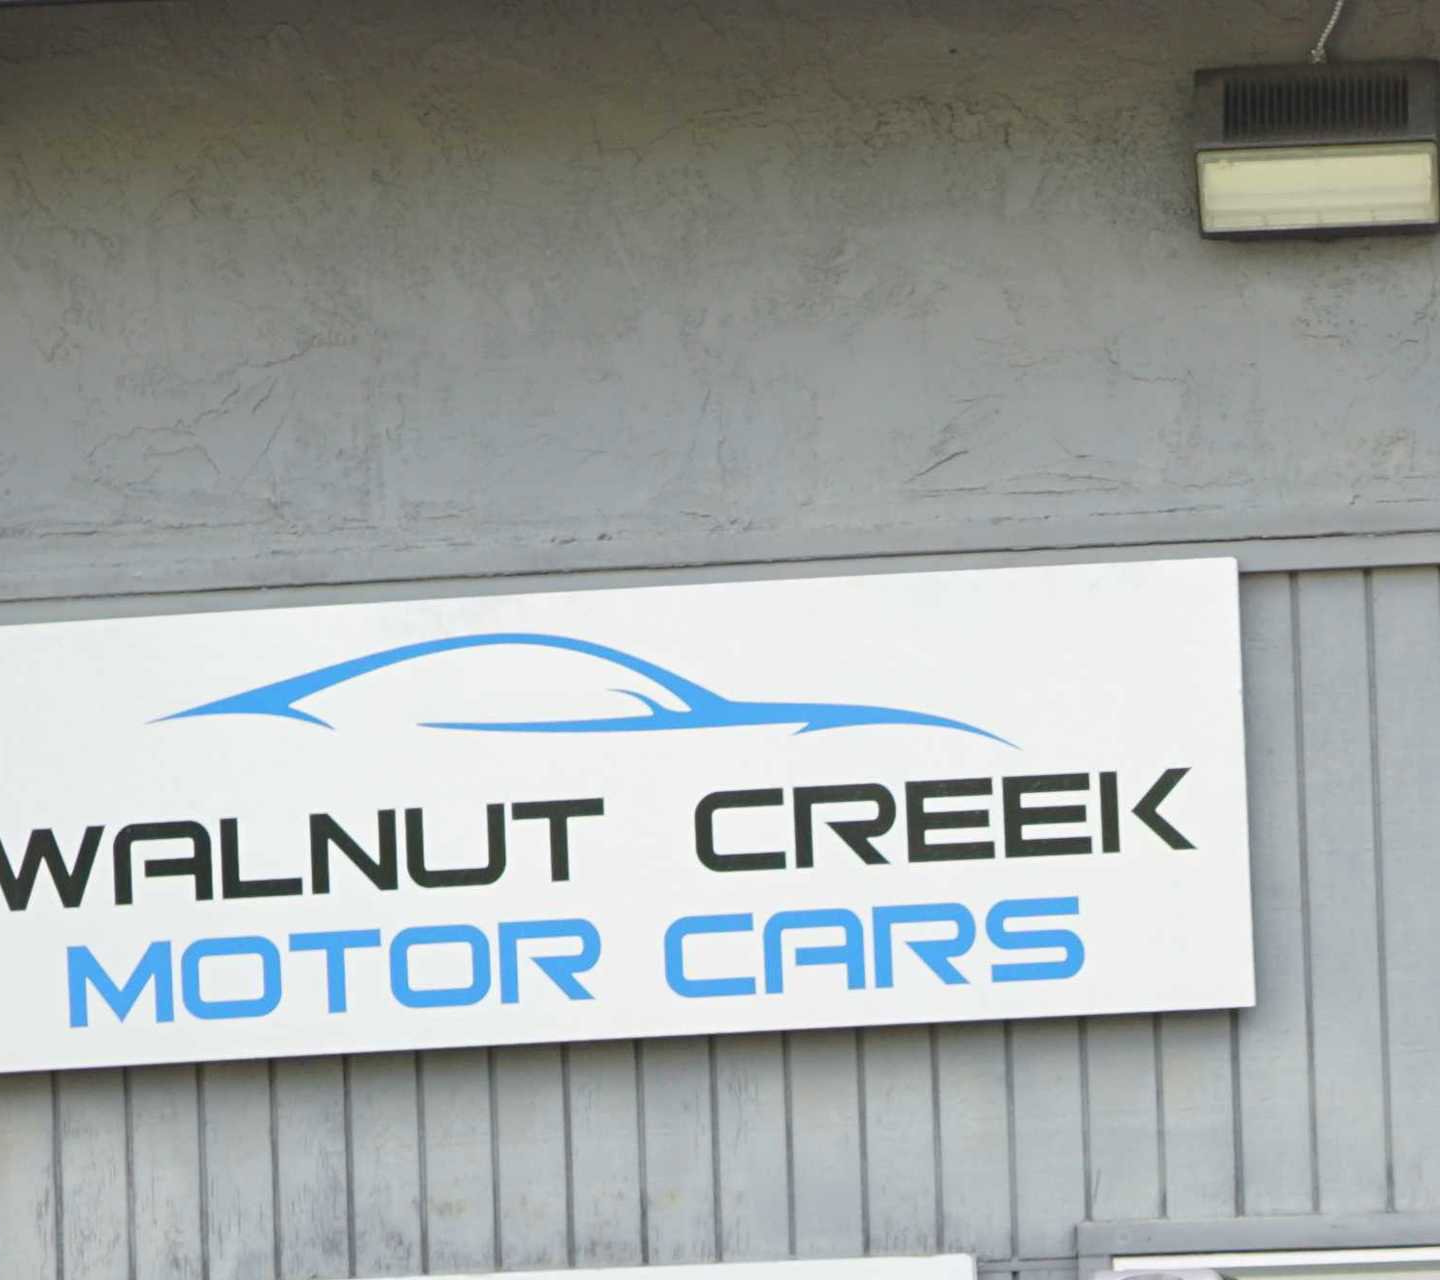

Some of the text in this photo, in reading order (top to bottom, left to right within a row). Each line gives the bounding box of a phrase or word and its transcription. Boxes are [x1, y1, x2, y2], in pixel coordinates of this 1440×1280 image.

[694, 768, 1196, 872] CREEK
[67, 895, 1086, 1028] MOTOR CARS
